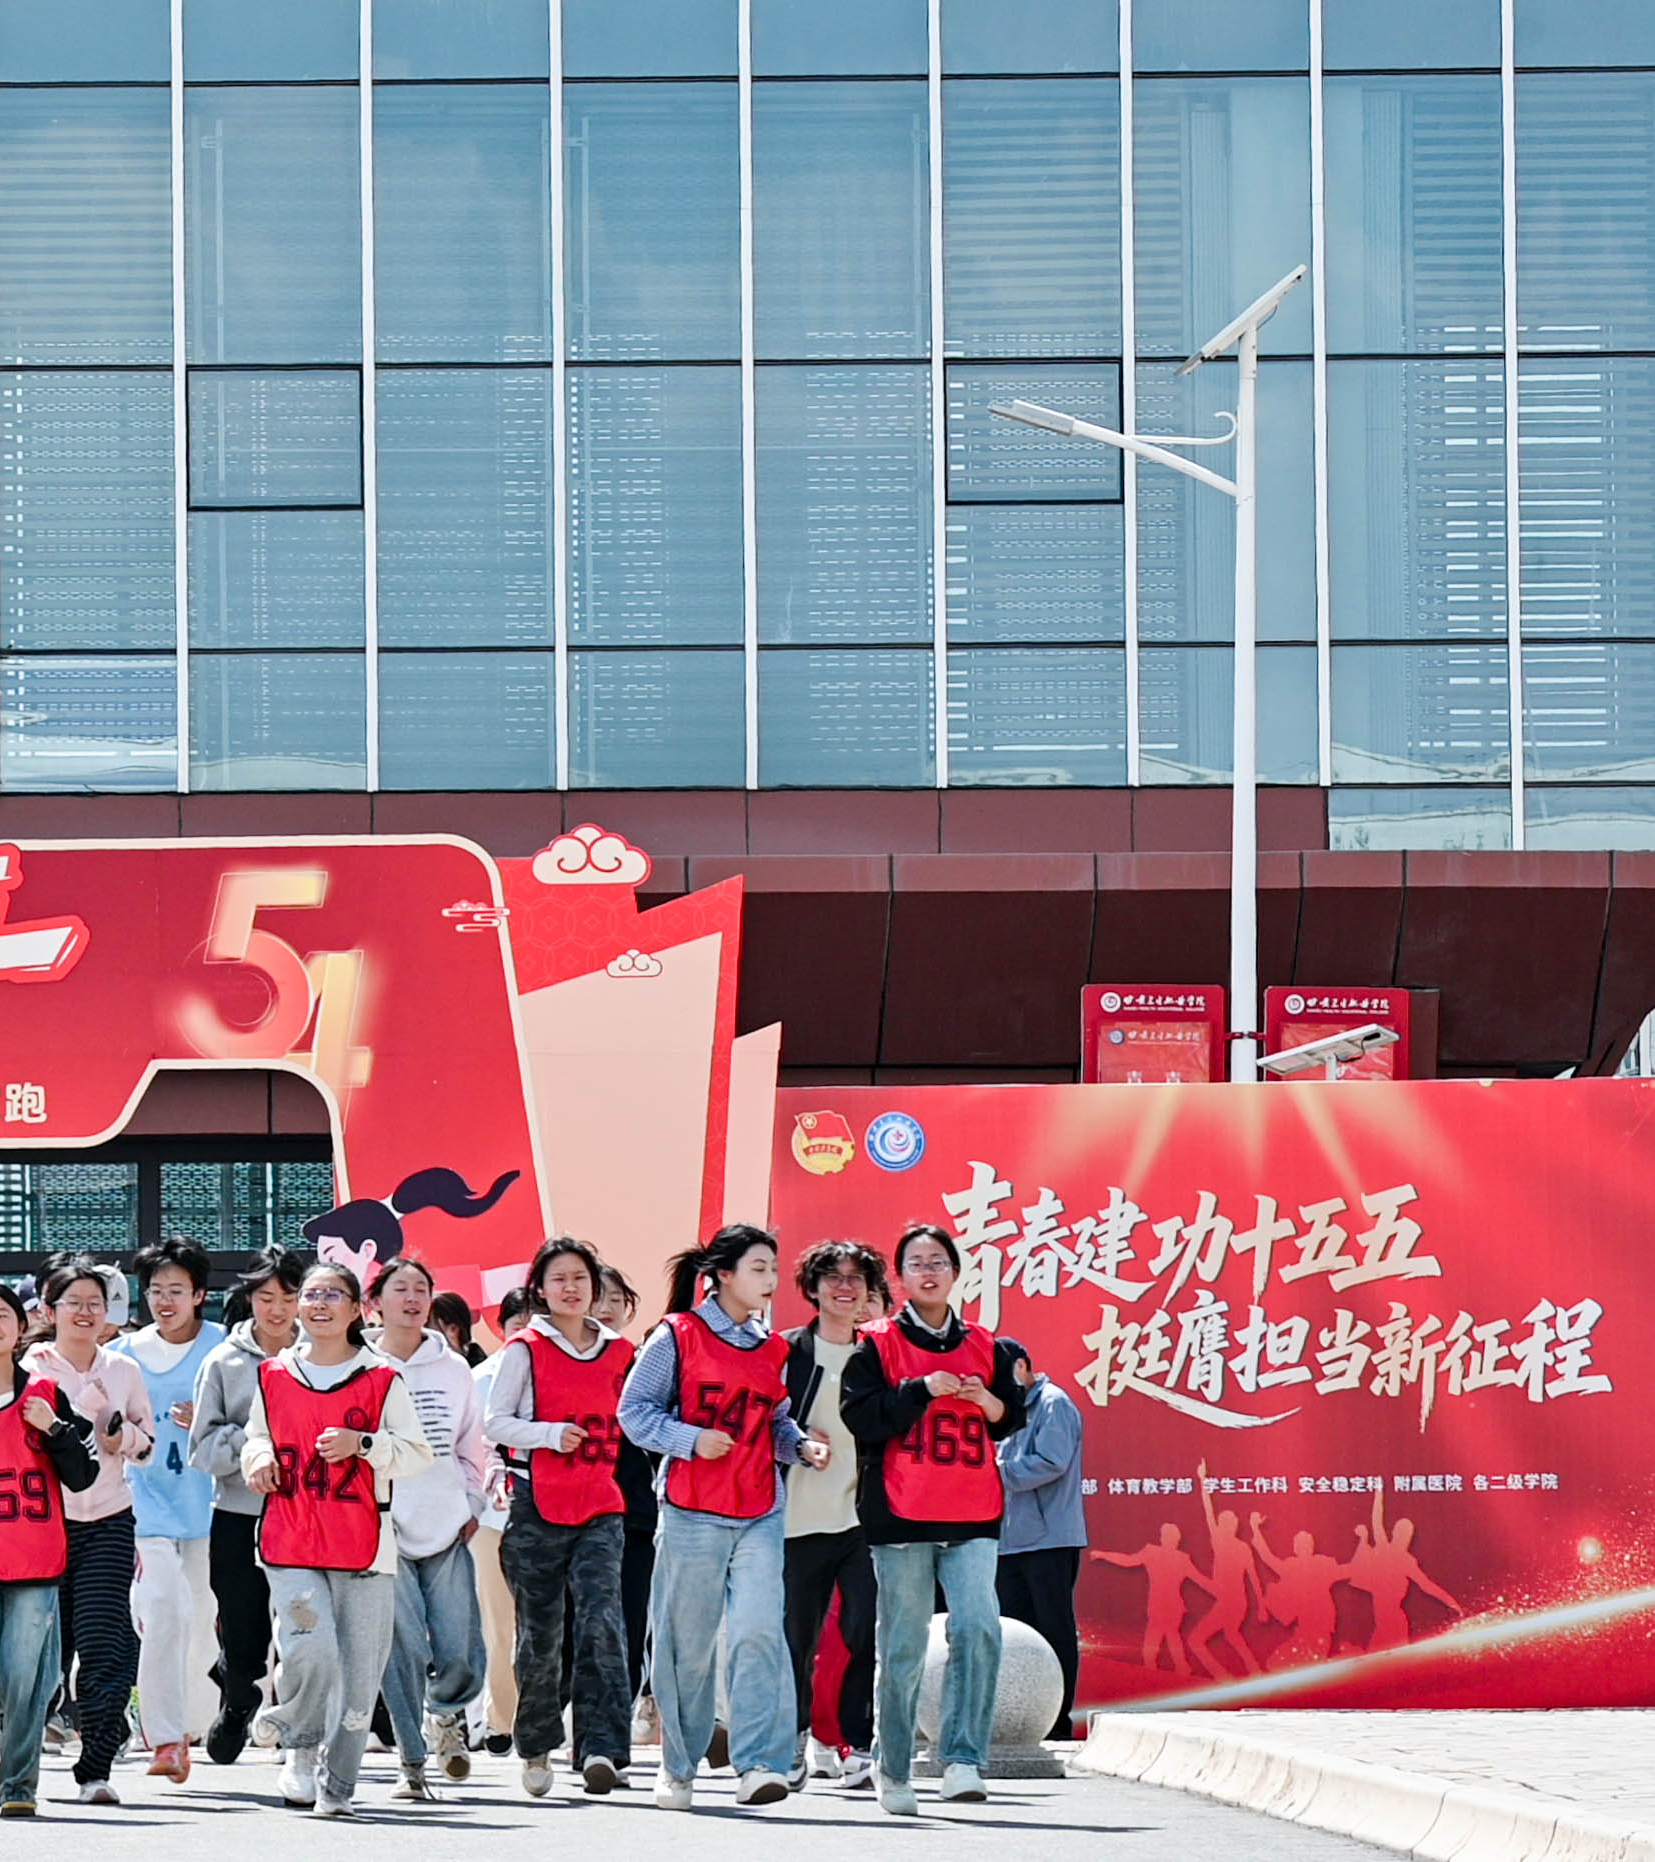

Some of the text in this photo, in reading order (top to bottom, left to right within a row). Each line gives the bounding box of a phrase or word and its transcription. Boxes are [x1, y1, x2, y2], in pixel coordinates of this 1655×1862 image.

[941, 1160, 1443, 1334] 青春建功十五五
[1073, 1289, 1613, 1434] 挺膺担当新征程
[697, 1382, 775, 1447] 547
[898, 1410, 987, 1469] 469
[166, 1441, 184, 1475] 4
[1107, 1477, 1193, 1495] 体育教学部
[1203, 1476, 1289, 1494] 学生工作科
[1298, 1475, 1384, 1493] 安全稳定科
[1393, 1474, 1464, 1492] 附属医院
[1472, 1472, 1559, 1491] 各二级学院
